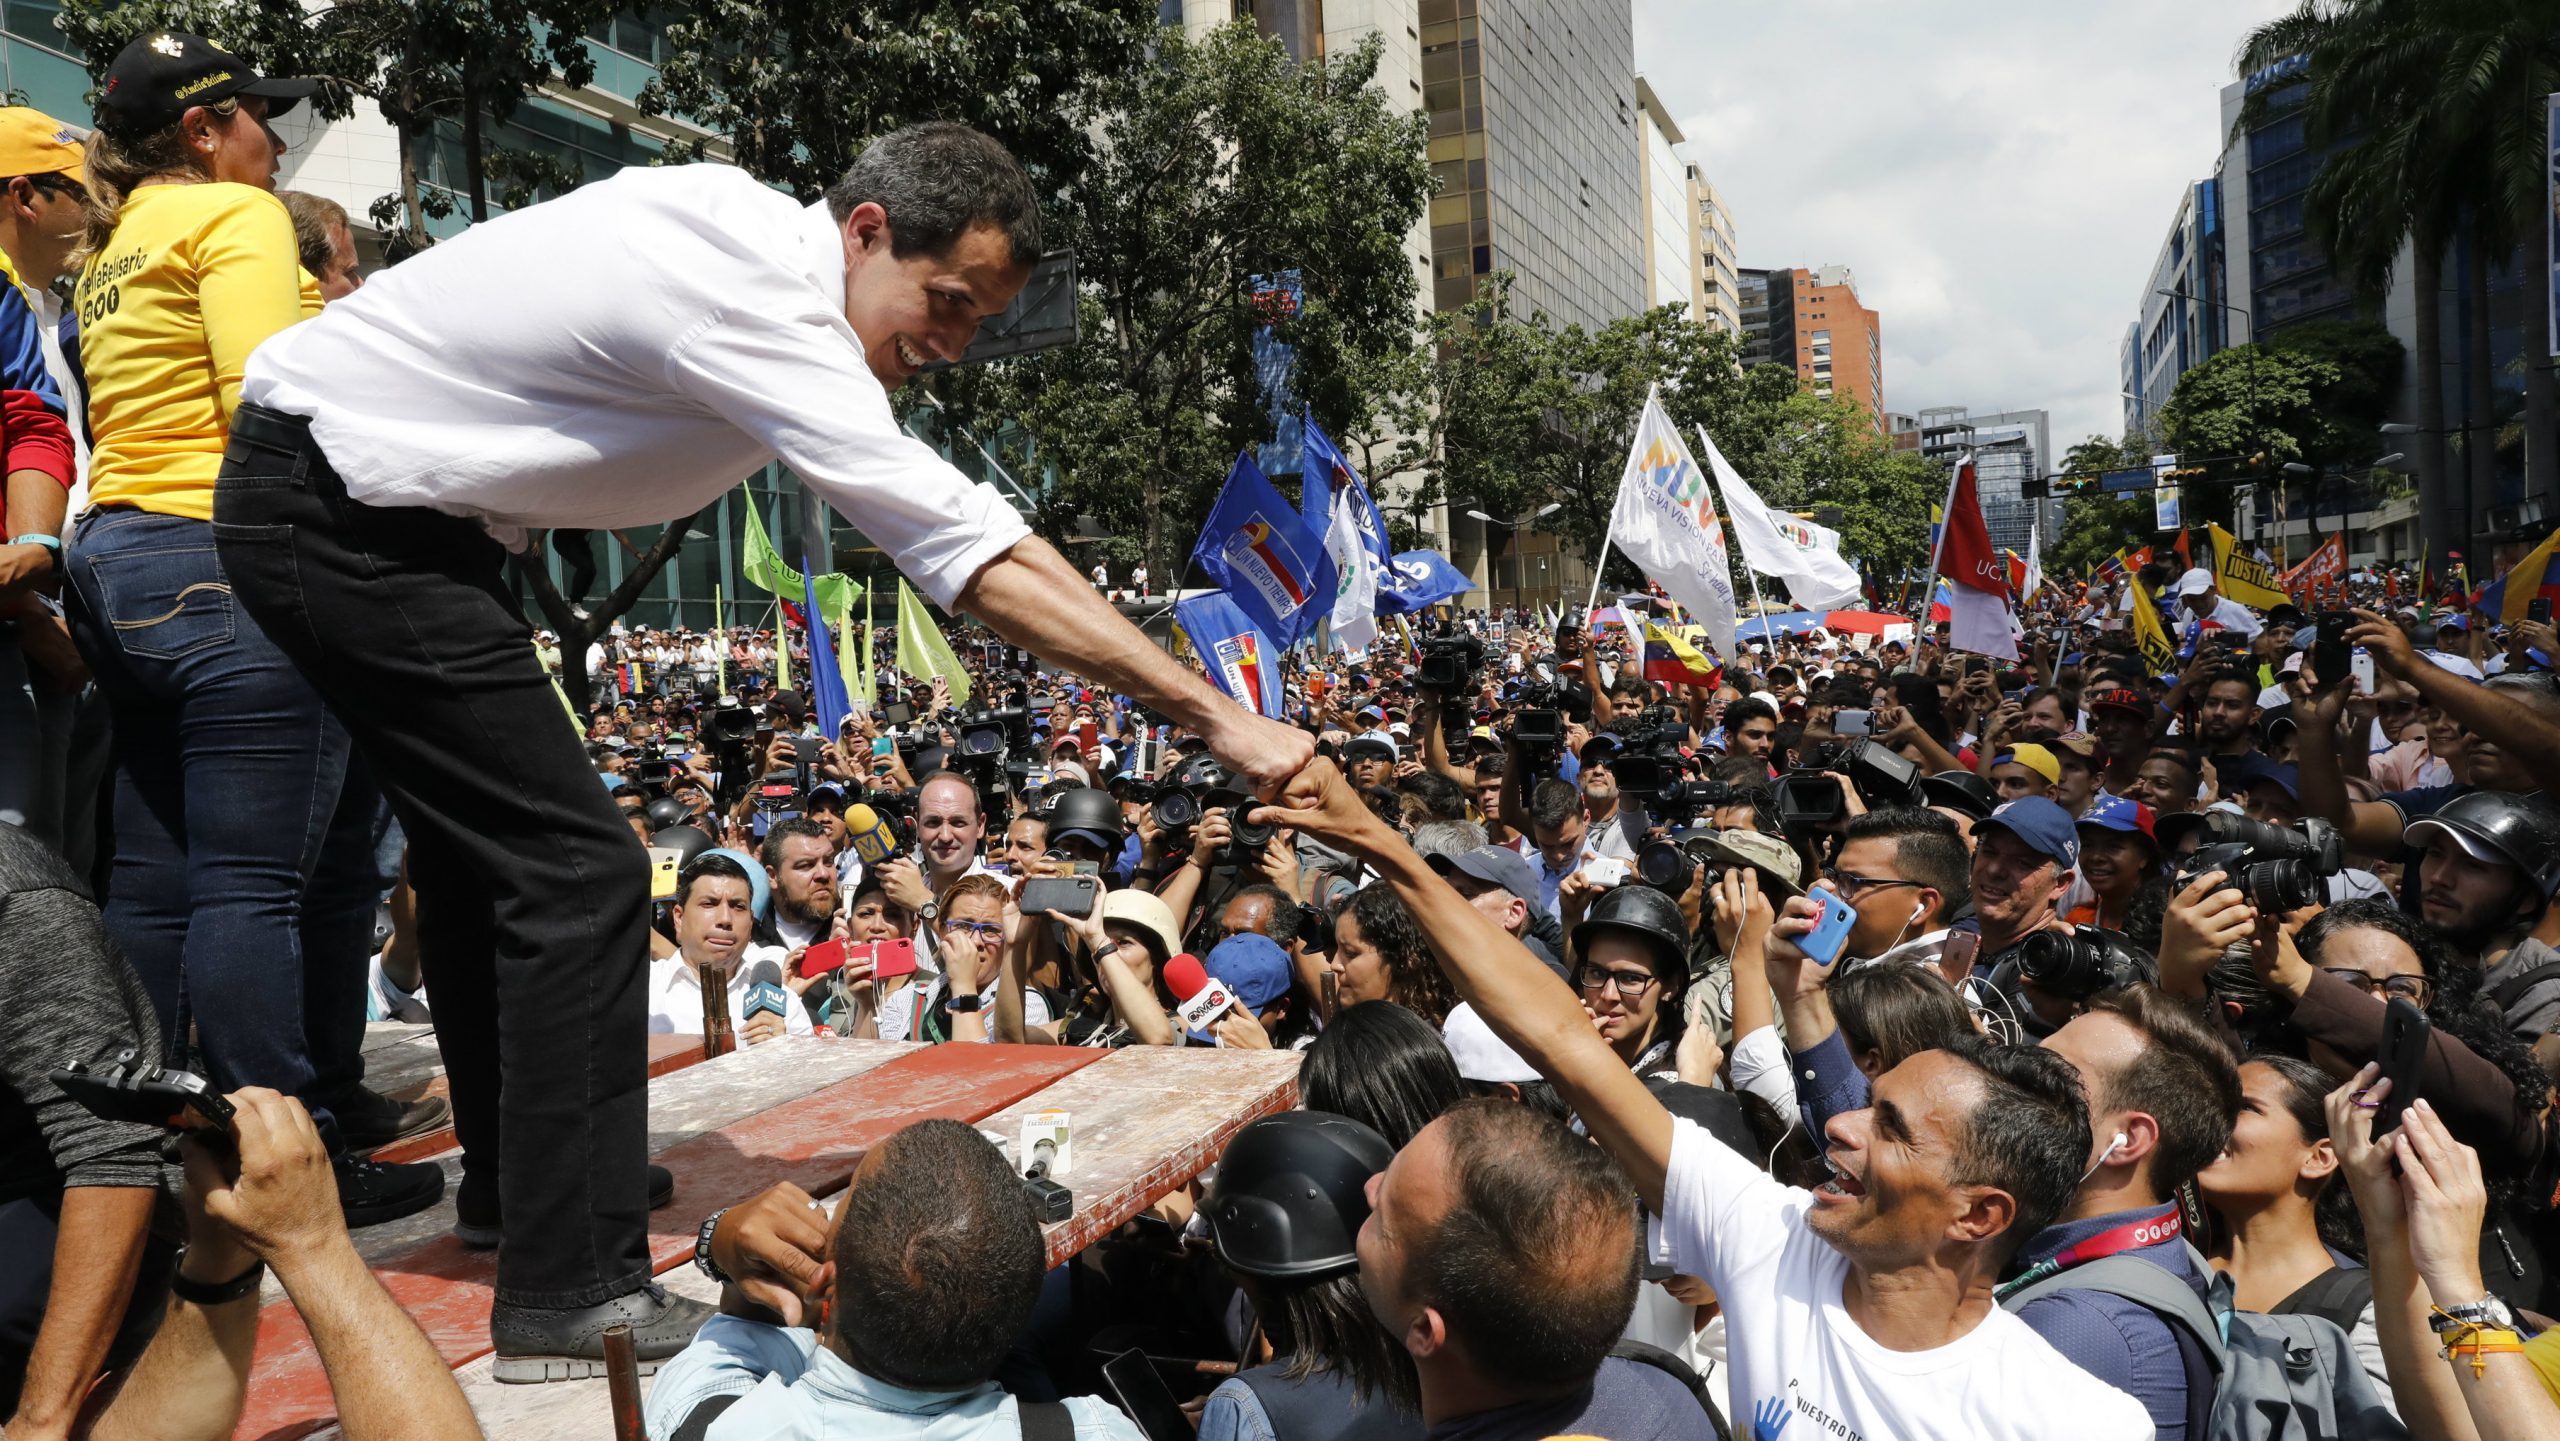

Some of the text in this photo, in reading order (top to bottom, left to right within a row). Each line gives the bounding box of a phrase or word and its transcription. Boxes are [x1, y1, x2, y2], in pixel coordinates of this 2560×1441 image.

[1636, 473, 1729, 569] NUEVA VISIÓN PAR
[1236, 548, 1252, 568] UN
[1247, 558, 1274, 587] NUEVO
[1267, 581, 1293, 615] TIEMPO
[1976, 559, 2002, 582] UC
[1227, 666, 1237, 681] UN
[2182, 1179, 2201, 1228] Cano
